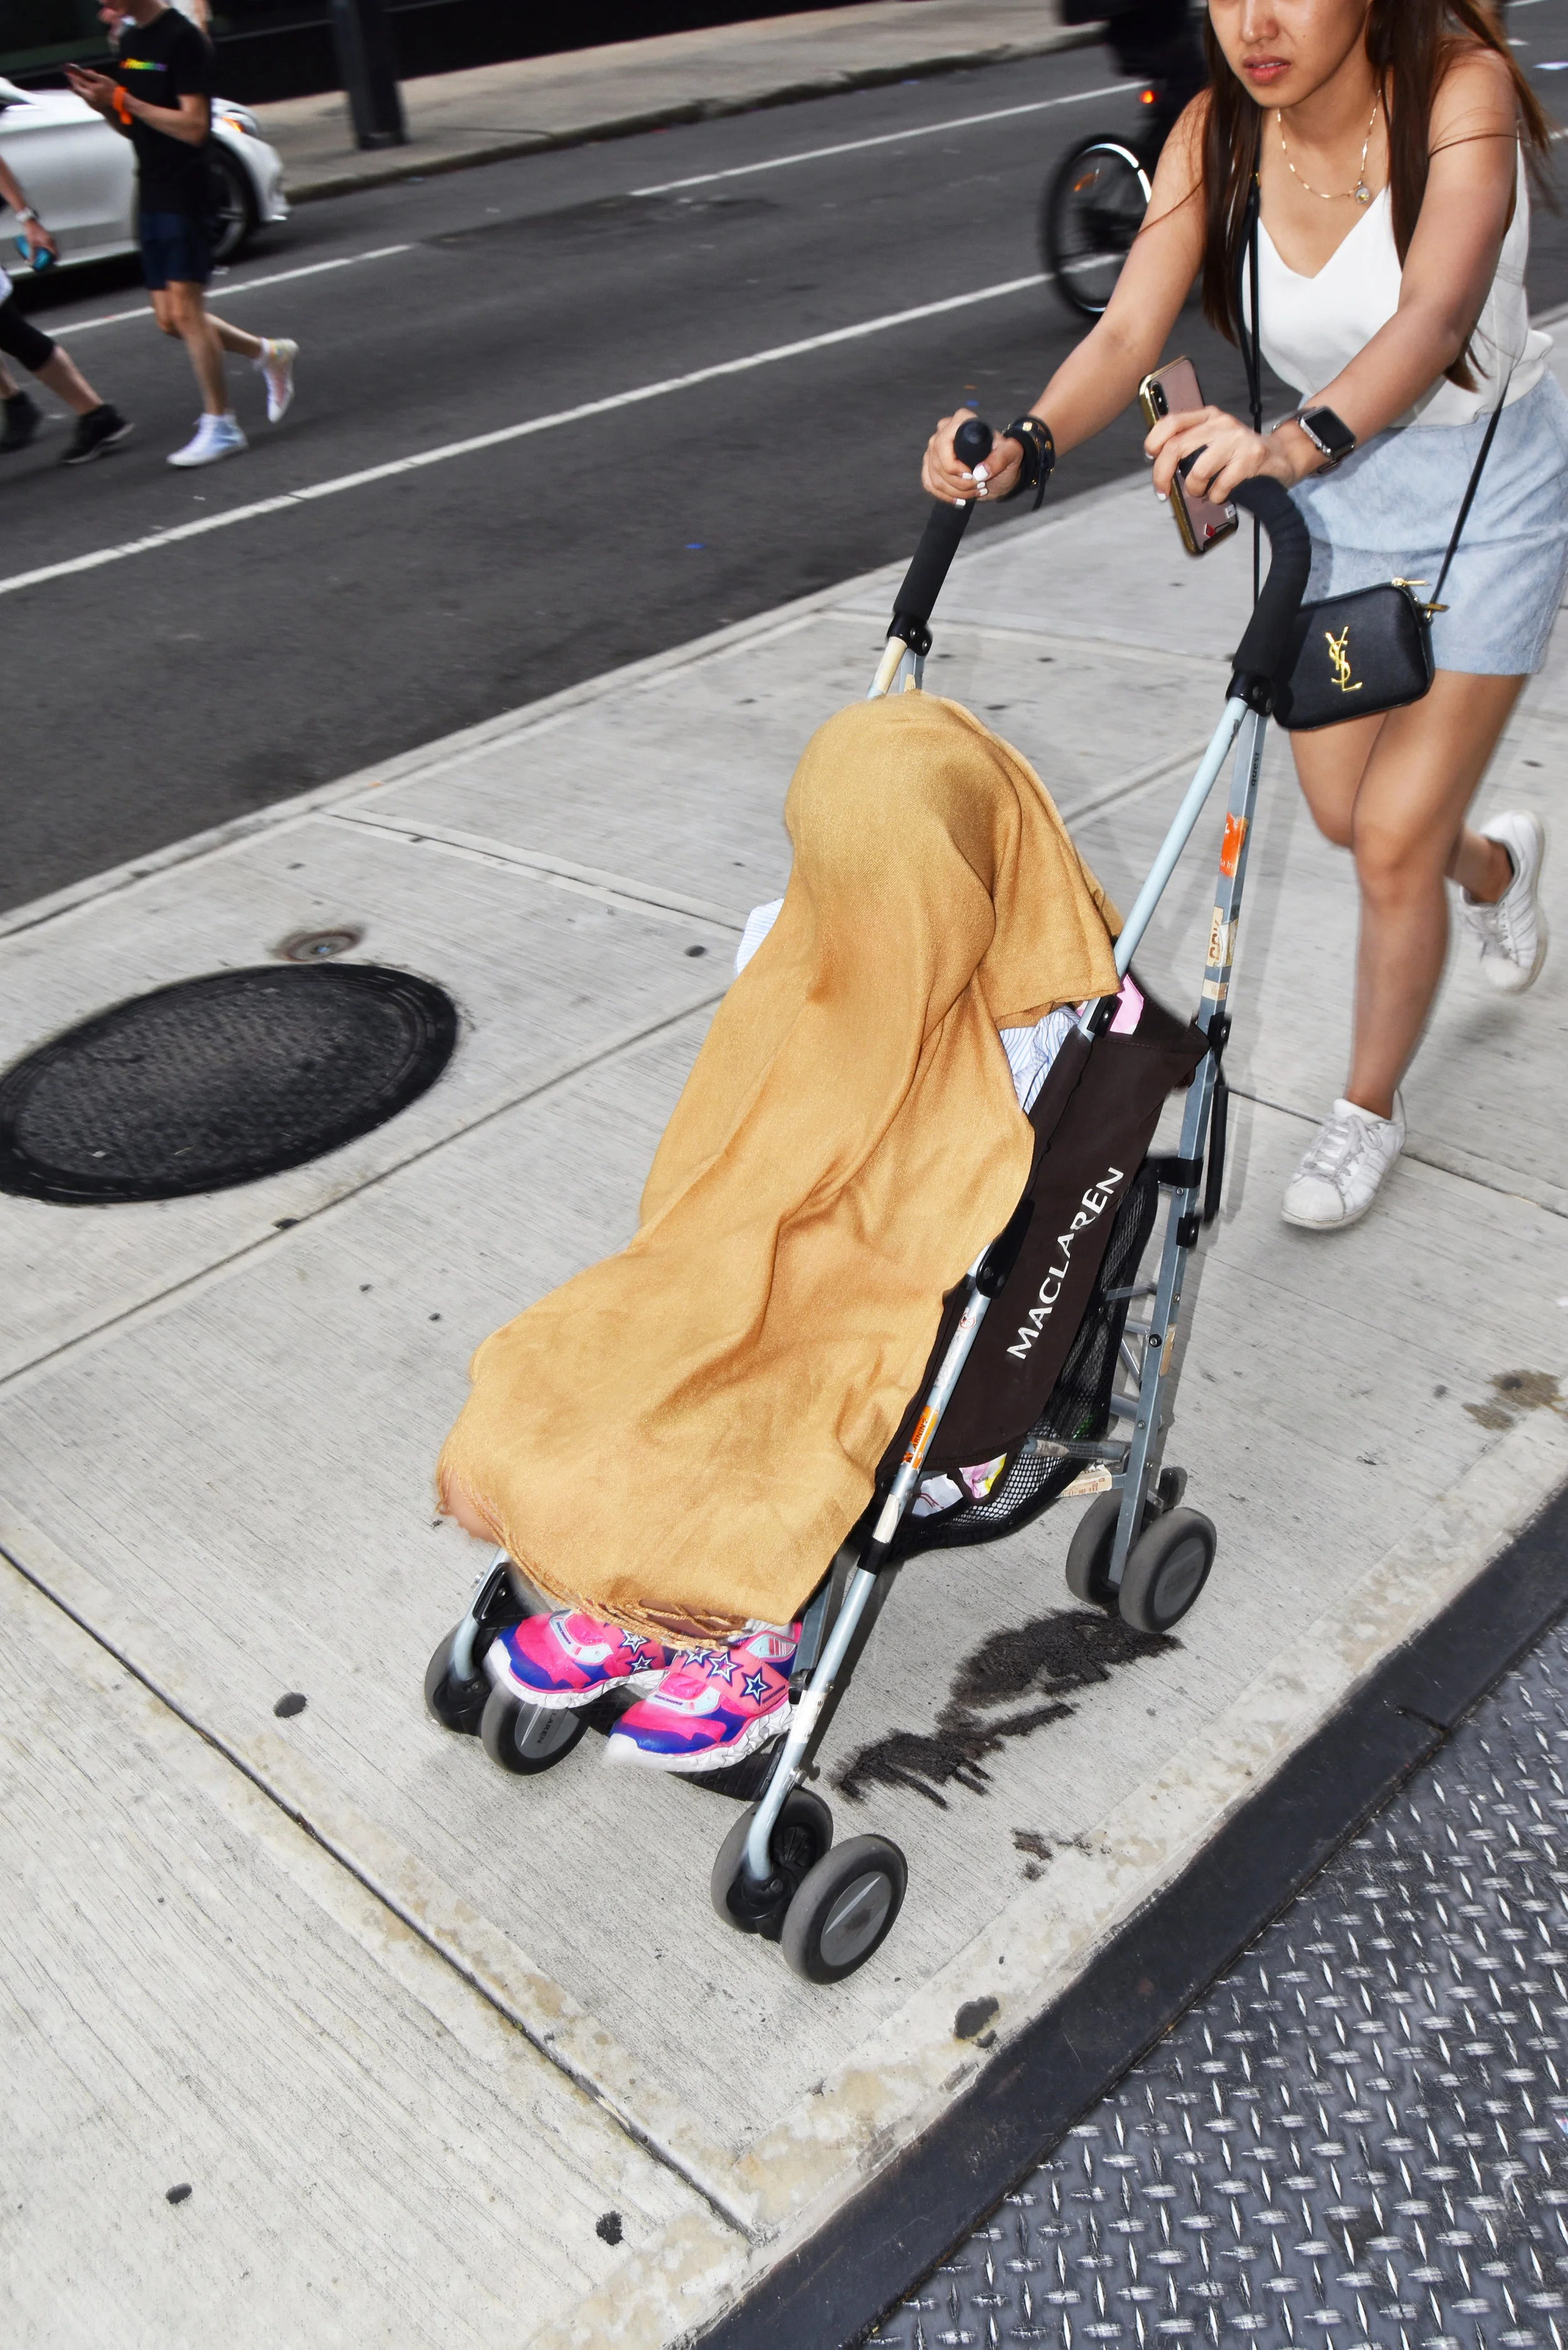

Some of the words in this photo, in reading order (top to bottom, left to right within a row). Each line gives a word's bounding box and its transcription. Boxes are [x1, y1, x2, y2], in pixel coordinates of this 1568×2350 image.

[1325, 626, 1362, 692] YSL
[1006, 1167, 1124, 1359] MACLAREN
[913, 1418, 928, 1451] ARNING
